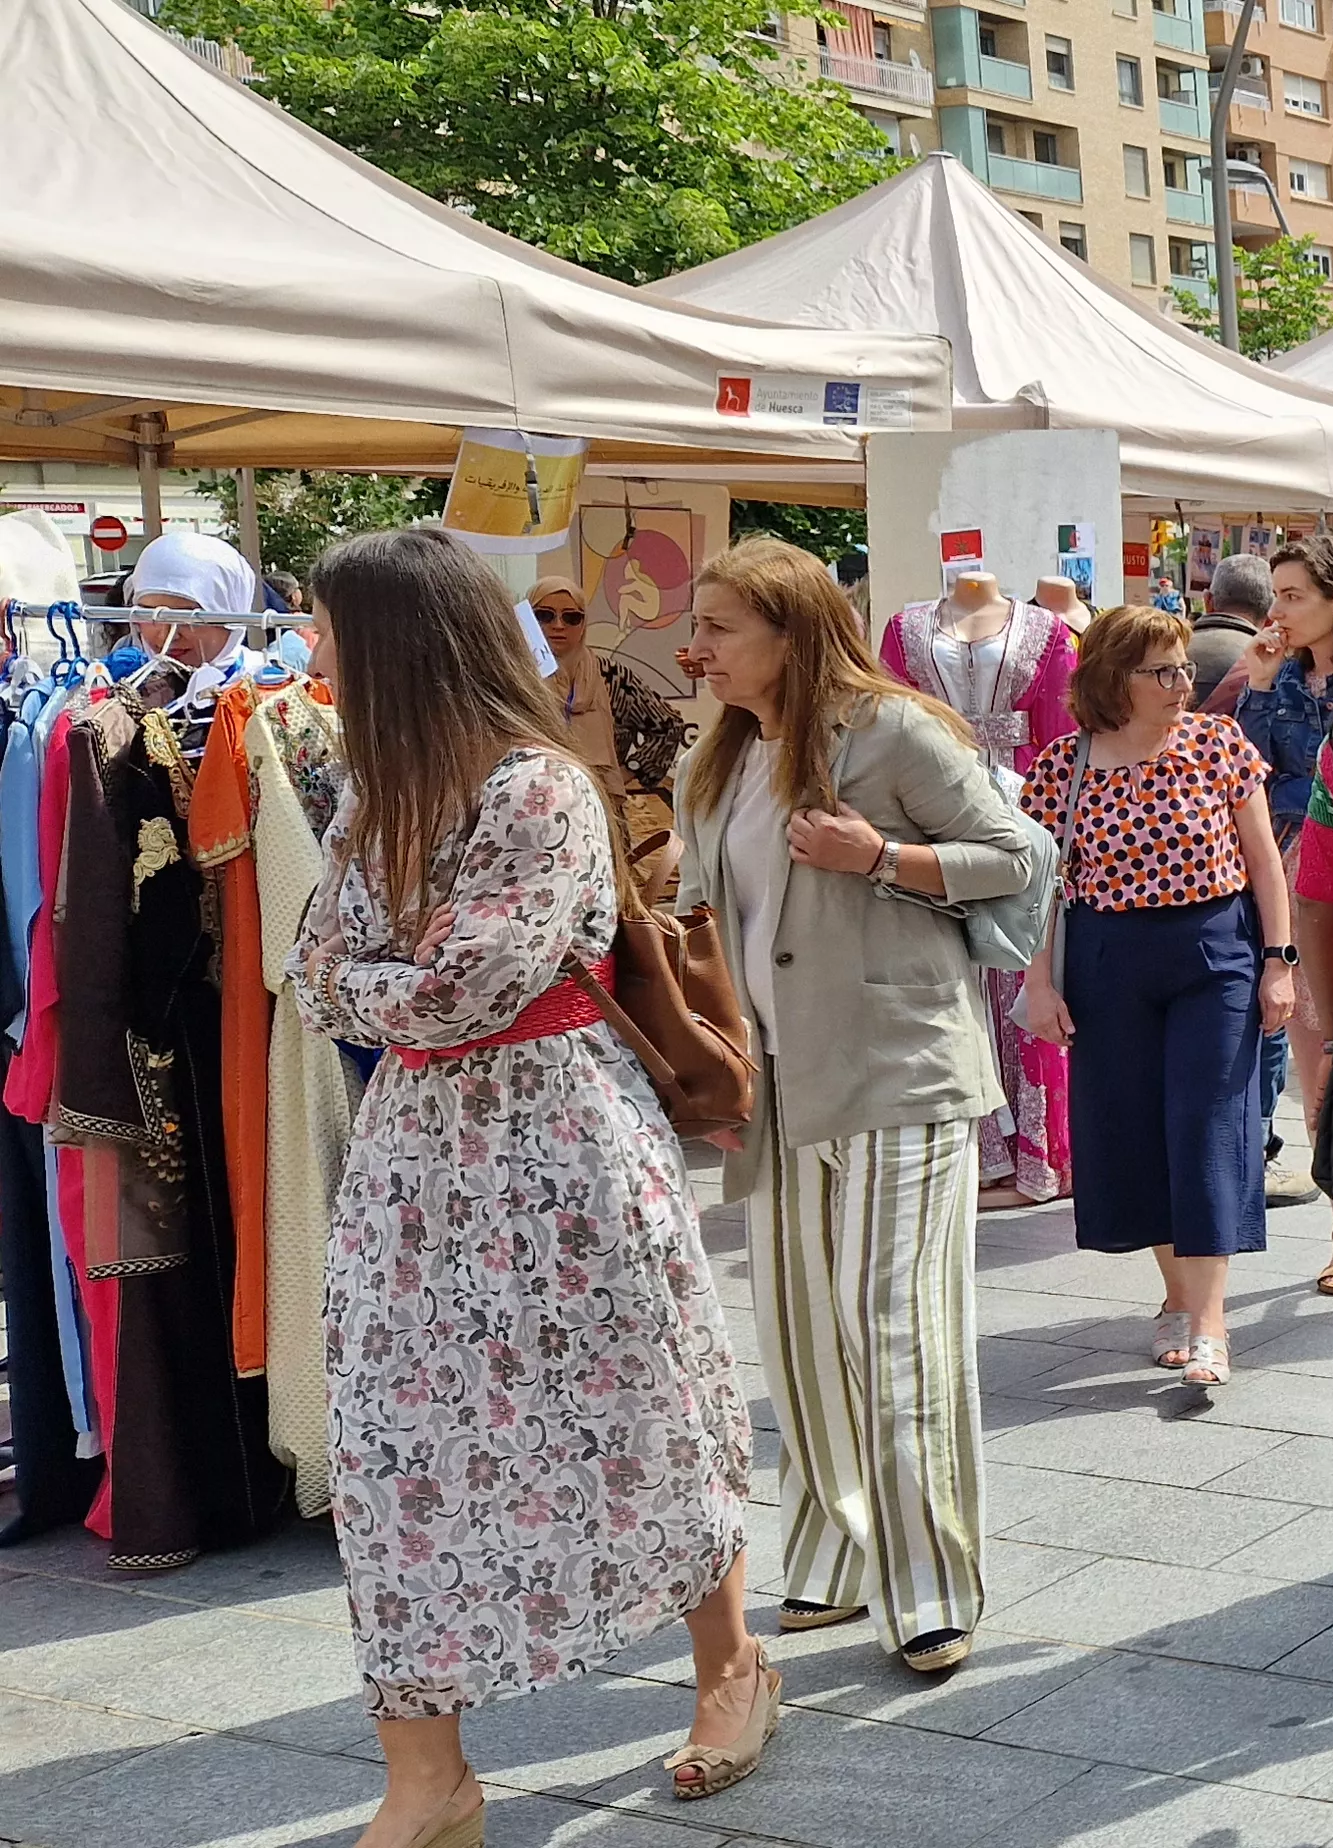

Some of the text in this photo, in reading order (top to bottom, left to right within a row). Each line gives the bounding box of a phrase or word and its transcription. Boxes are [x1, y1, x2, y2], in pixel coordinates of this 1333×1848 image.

[756, 388, 819, 401] Ayuntamiento
[754, 401, 803, 414] de Huesca
[1124, 555, 1146, 566] USTO
